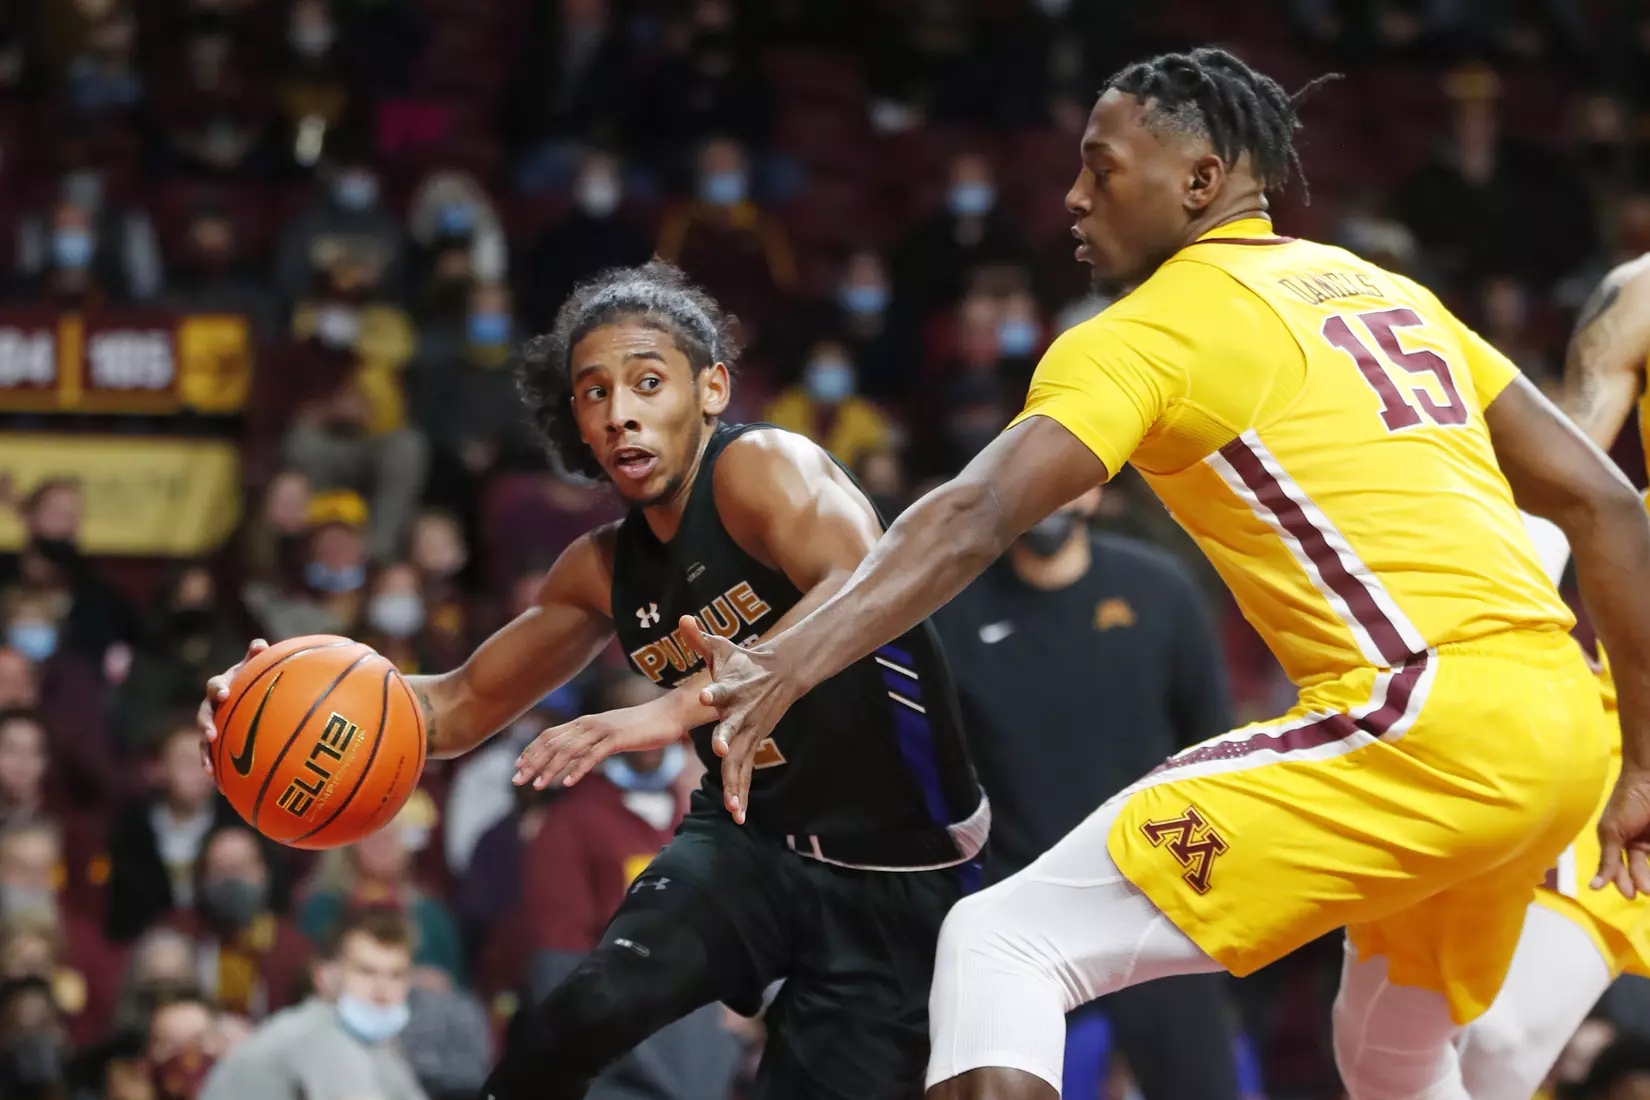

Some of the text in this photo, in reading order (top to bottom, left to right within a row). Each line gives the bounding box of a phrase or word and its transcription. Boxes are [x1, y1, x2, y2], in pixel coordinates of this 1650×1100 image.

[1278, 273, 1384, 305] DANIELS
[1321, 307, 1468, 432] 15
[630, 581, 772, 683] PURUE
[276, 712, 357, 819] ELITE
